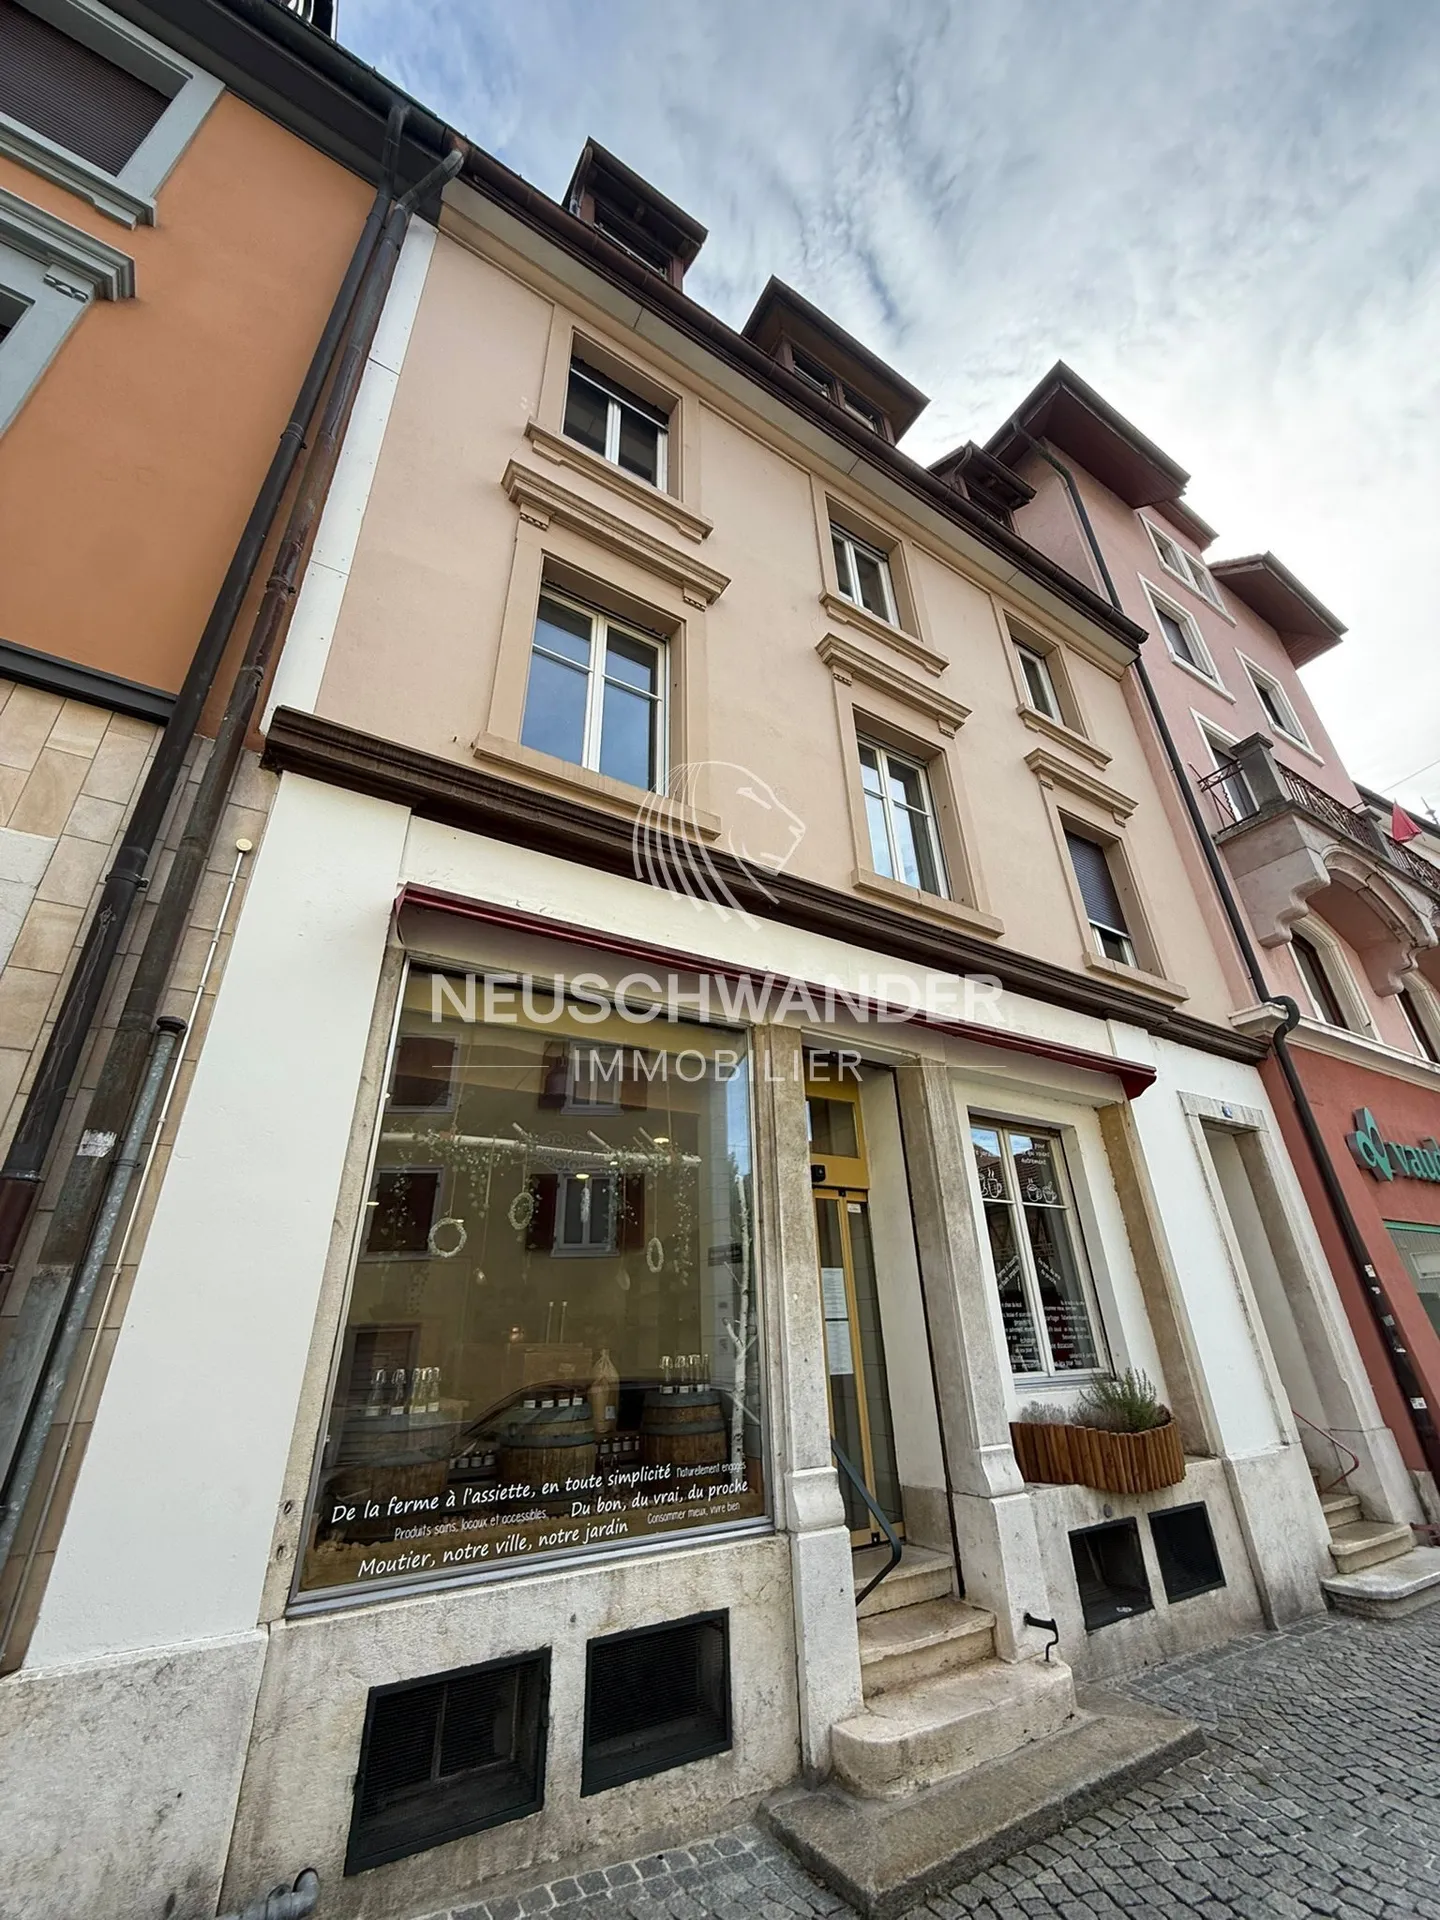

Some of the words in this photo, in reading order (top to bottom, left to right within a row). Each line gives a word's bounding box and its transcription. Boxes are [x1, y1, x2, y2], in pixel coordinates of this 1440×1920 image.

[331, 1505, 356, 1524] De
[364, 1500, 380, 1519] la
[387, 1496, 440, 1516] ferme
[446, 1490, 456, 1507] à
[463, 1483, 537, 1506] l'assiette,
[542, 1481, 559, 1495] en
[565, 1474, 603, 1491] toute
[608, 1463, 672, 1488] simplicité
[571, 1502, 591, 1518] Du
[597, 1496, 627, 1513] bon,
[631, 1491, 649, 1508] du
[654, 1486, 684, 1505] vrai,
[688, 1483, 704, 1500] du
[708, 1478, 749, 1502] proche
[647, 1510, 687, 1525] Consommer
[727, 1501, 740, 1513] bien
[394, 1524, 432, 1541] Produits
[461, 1517, 488, 1533] locaux
[489, 1514, 500, 1527] et
[358, 1552, 436, 1578] Moutier,
[443, 1544, 490, 1564] notre
[496, 1533, 533, 1554] ville,
[538, 1527, 580, 1547] notre
[583, 1518, 629, 1545] jardin
